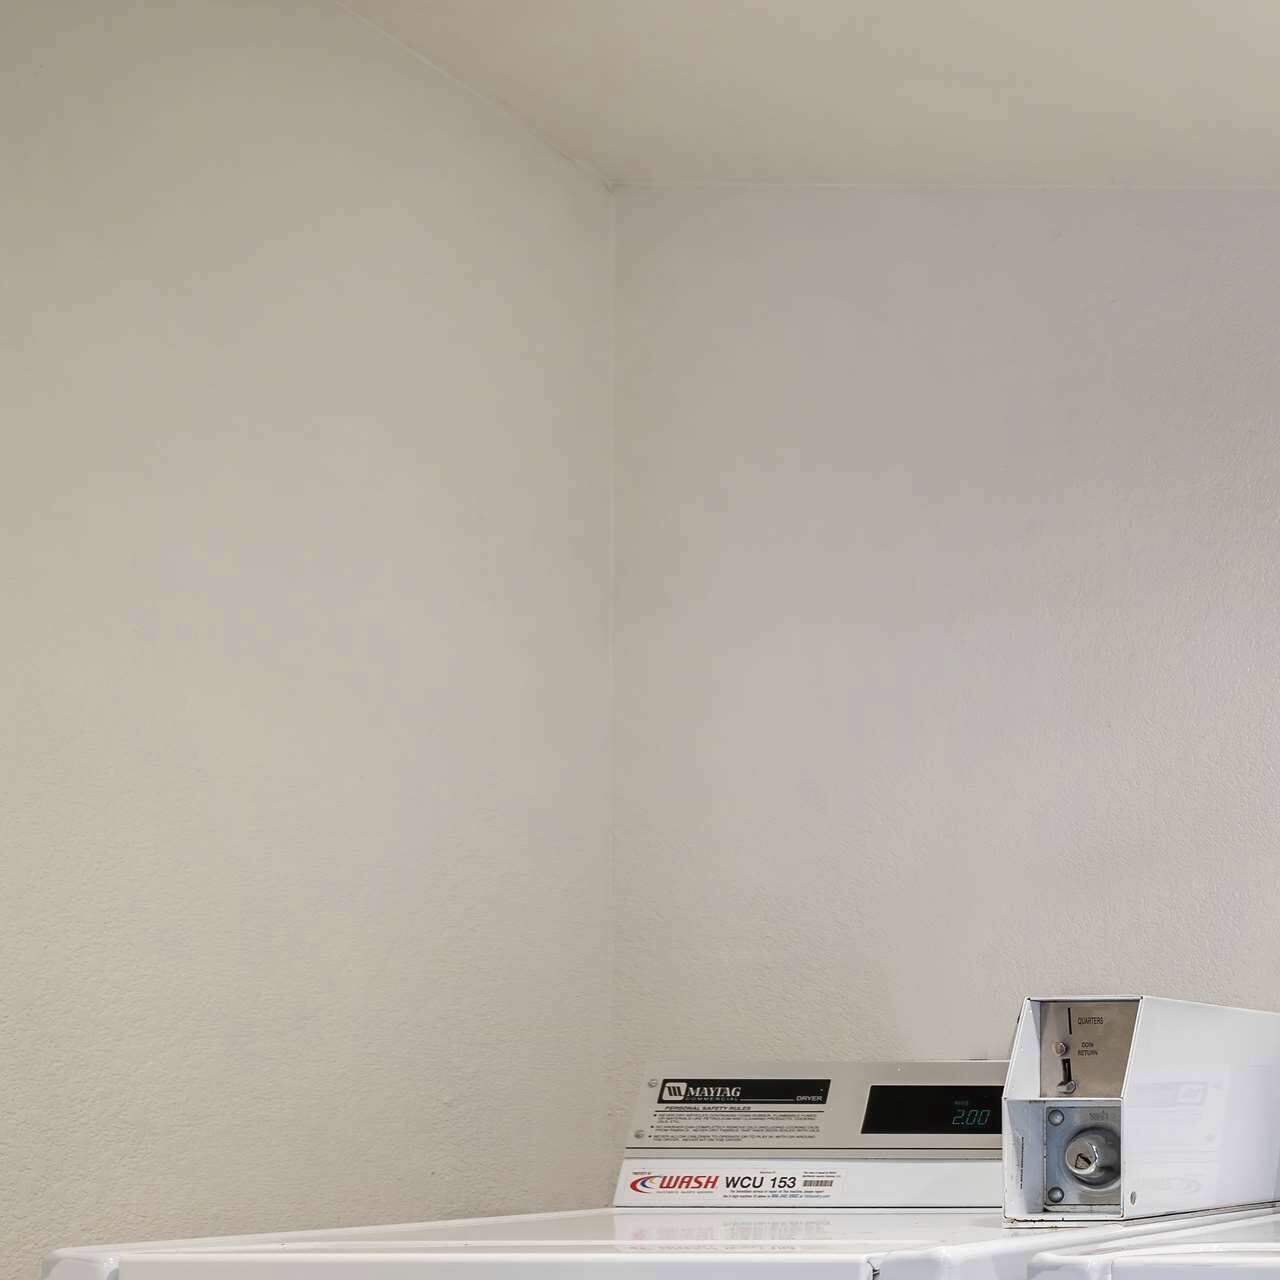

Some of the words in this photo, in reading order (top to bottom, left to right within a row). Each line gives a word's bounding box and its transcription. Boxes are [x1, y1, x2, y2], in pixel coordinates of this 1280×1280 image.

[687, 1087, 741, 1096] MAYTAG
[952, 1110, 991, 1125] 2.00
[659, 1176, 719, 1188] WASH
[725, 1177, 764, 1188] WCU
[770, 1177, 797, 1188] 153
